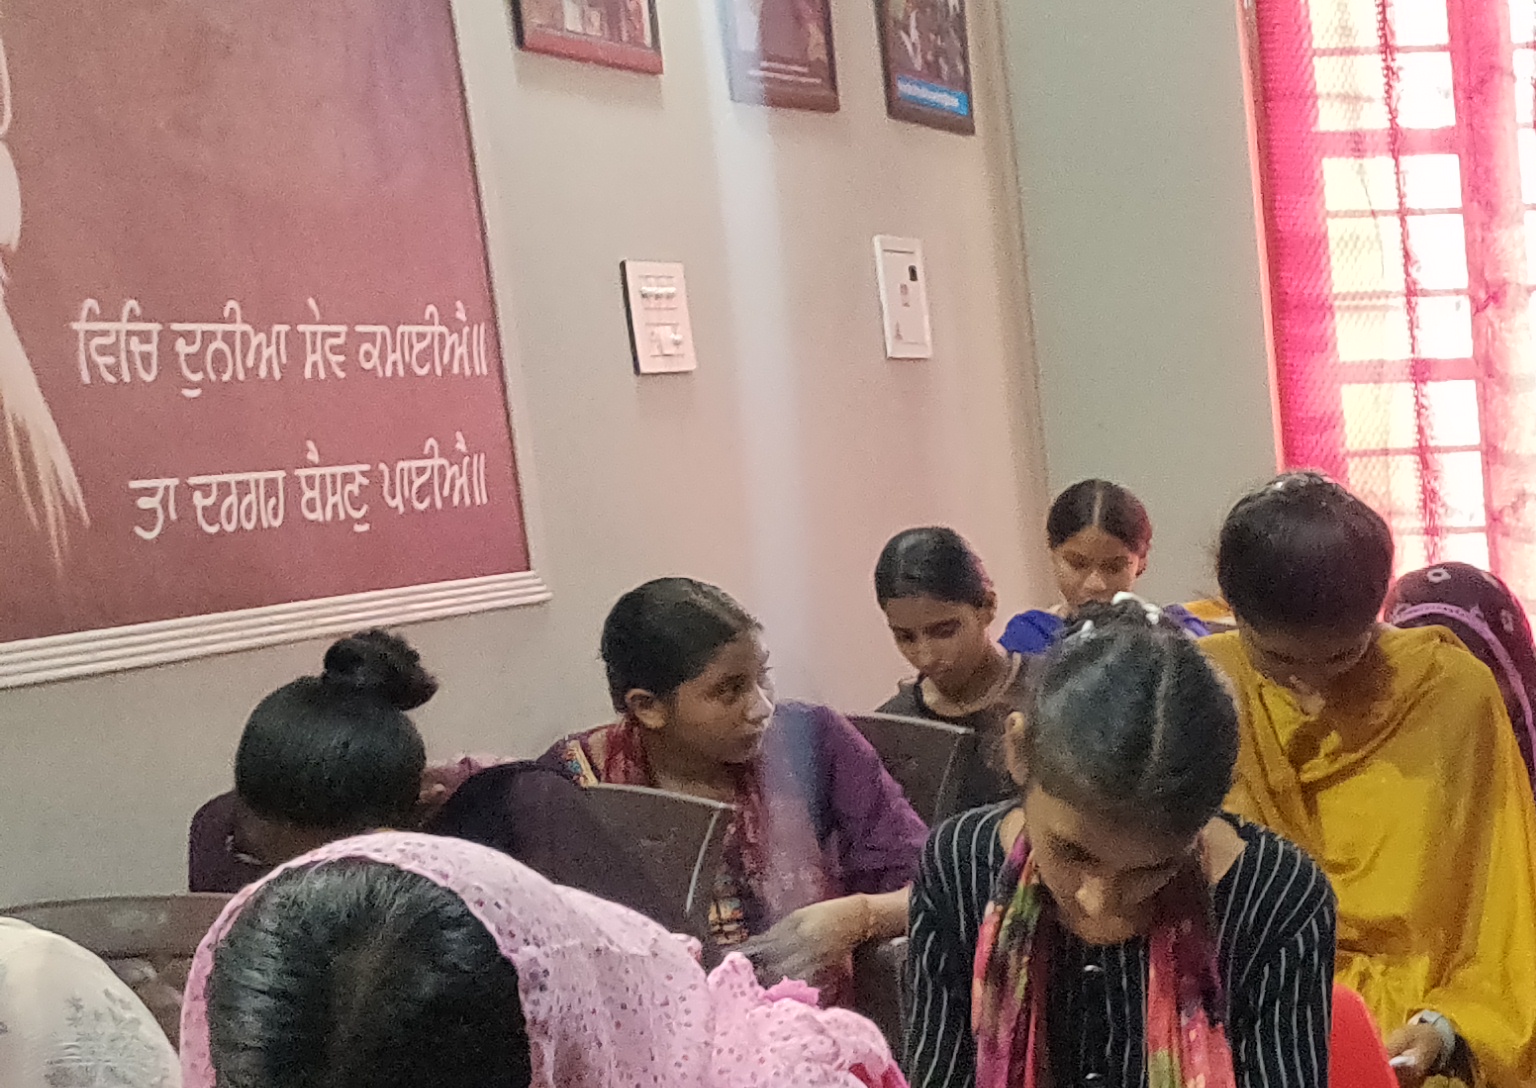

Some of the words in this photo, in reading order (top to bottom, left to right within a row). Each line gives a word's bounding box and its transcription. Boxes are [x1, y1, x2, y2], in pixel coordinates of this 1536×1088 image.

[70, 298, 163, 384] ਵਿਚਿ
[170, 300, 291, 398] ਦੁਨੀਆ
[297, 297, 348, 380] ਸੇਵ
[129, 478, 180, 540] ਤਾ
[187, 470, 287, 534] ਦਰਗਹ
[294, 440, 371, 532] ਬੈਸਣੁ
